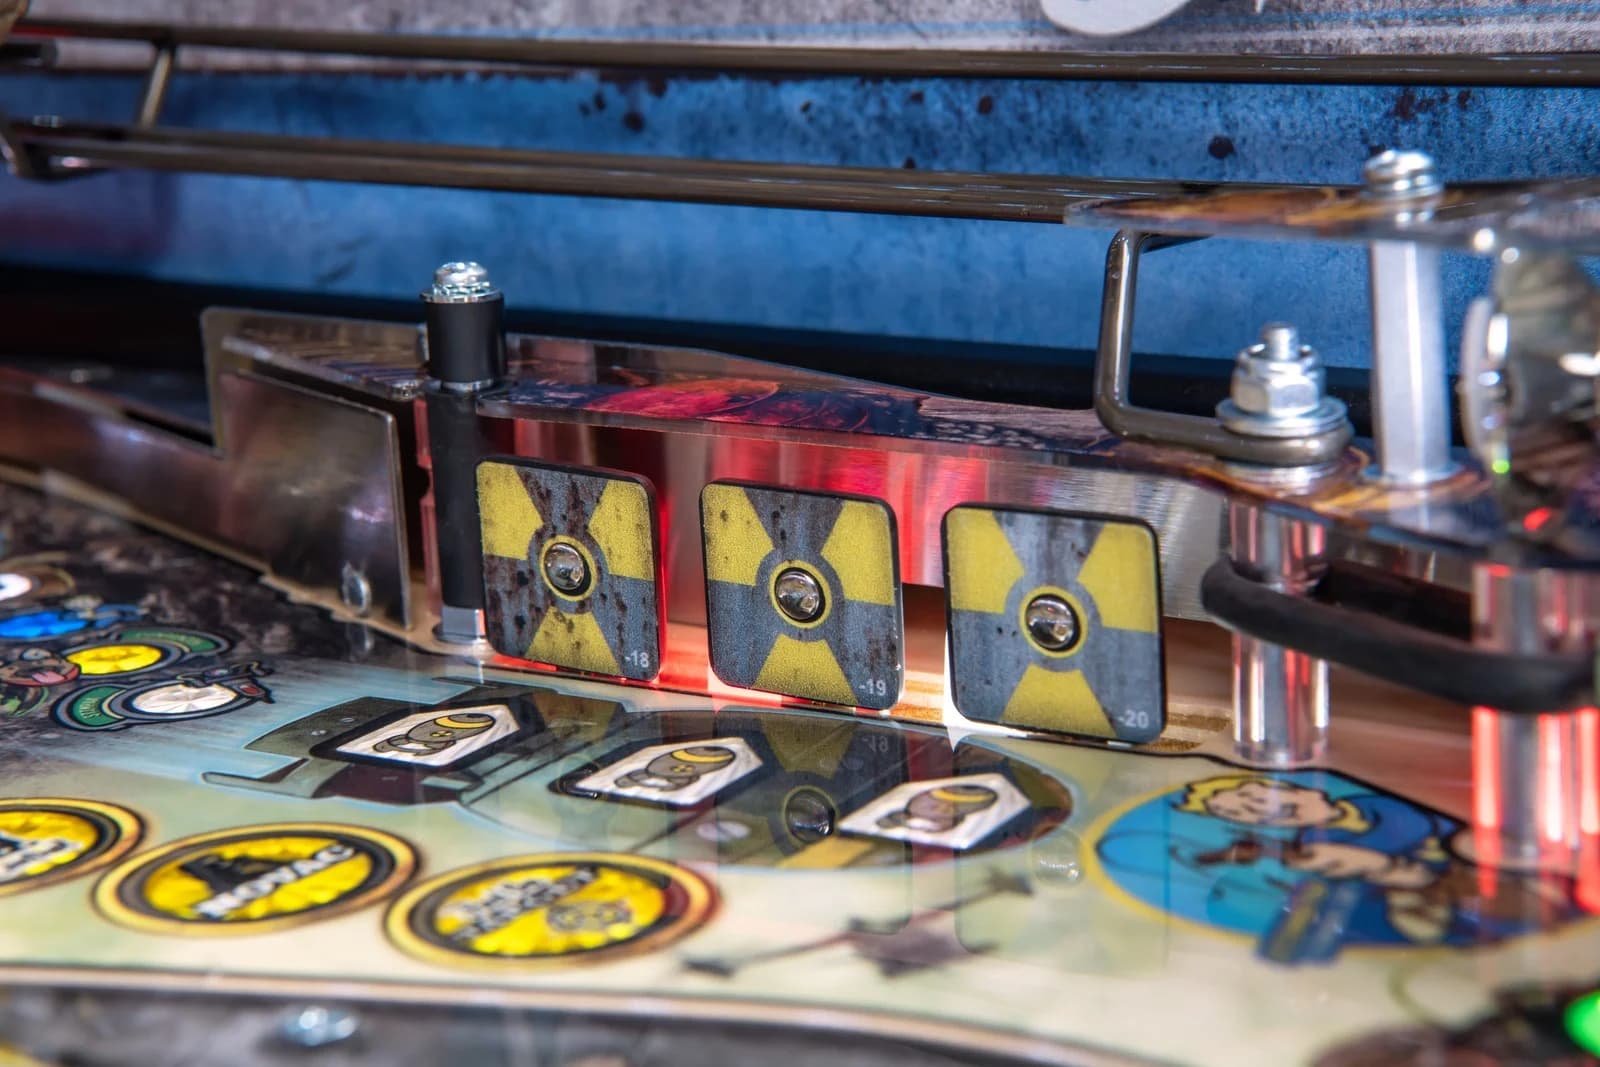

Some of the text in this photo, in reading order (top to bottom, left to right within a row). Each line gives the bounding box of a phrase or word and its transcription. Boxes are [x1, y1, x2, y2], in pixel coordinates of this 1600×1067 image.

[624, 650, 649, 668] -18
[858, 679, 886, 696] -19
[1117, 709, 1149, 729] -20
